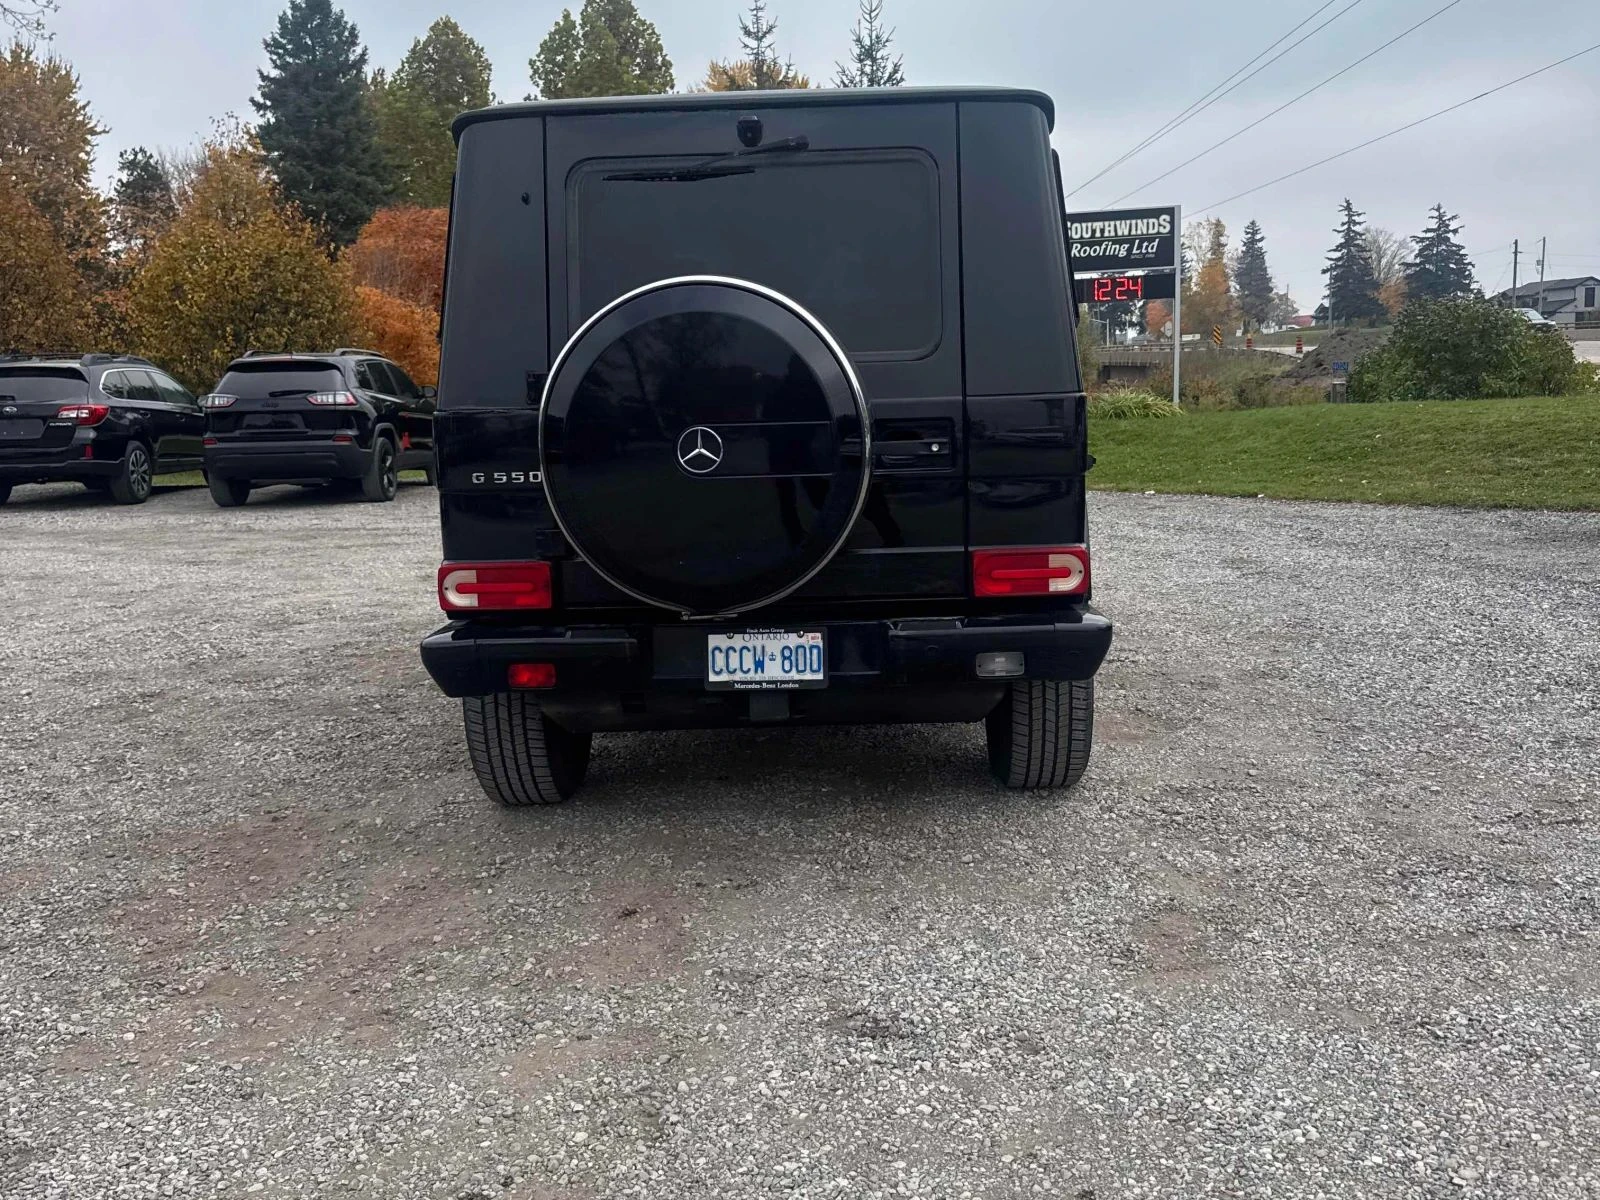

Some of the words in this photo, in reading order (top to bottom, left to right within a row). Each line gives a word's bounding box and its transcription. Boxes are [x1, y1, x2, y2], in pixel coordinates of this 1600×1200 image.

[1071, 241, 1130, 258] Roofing
[1132, 238, 1160, 254] Ltd
[472, 472, 485, 484] G
[493, 471, 541, 484] 550
[742, 632, 790, 642] ONTARIO
